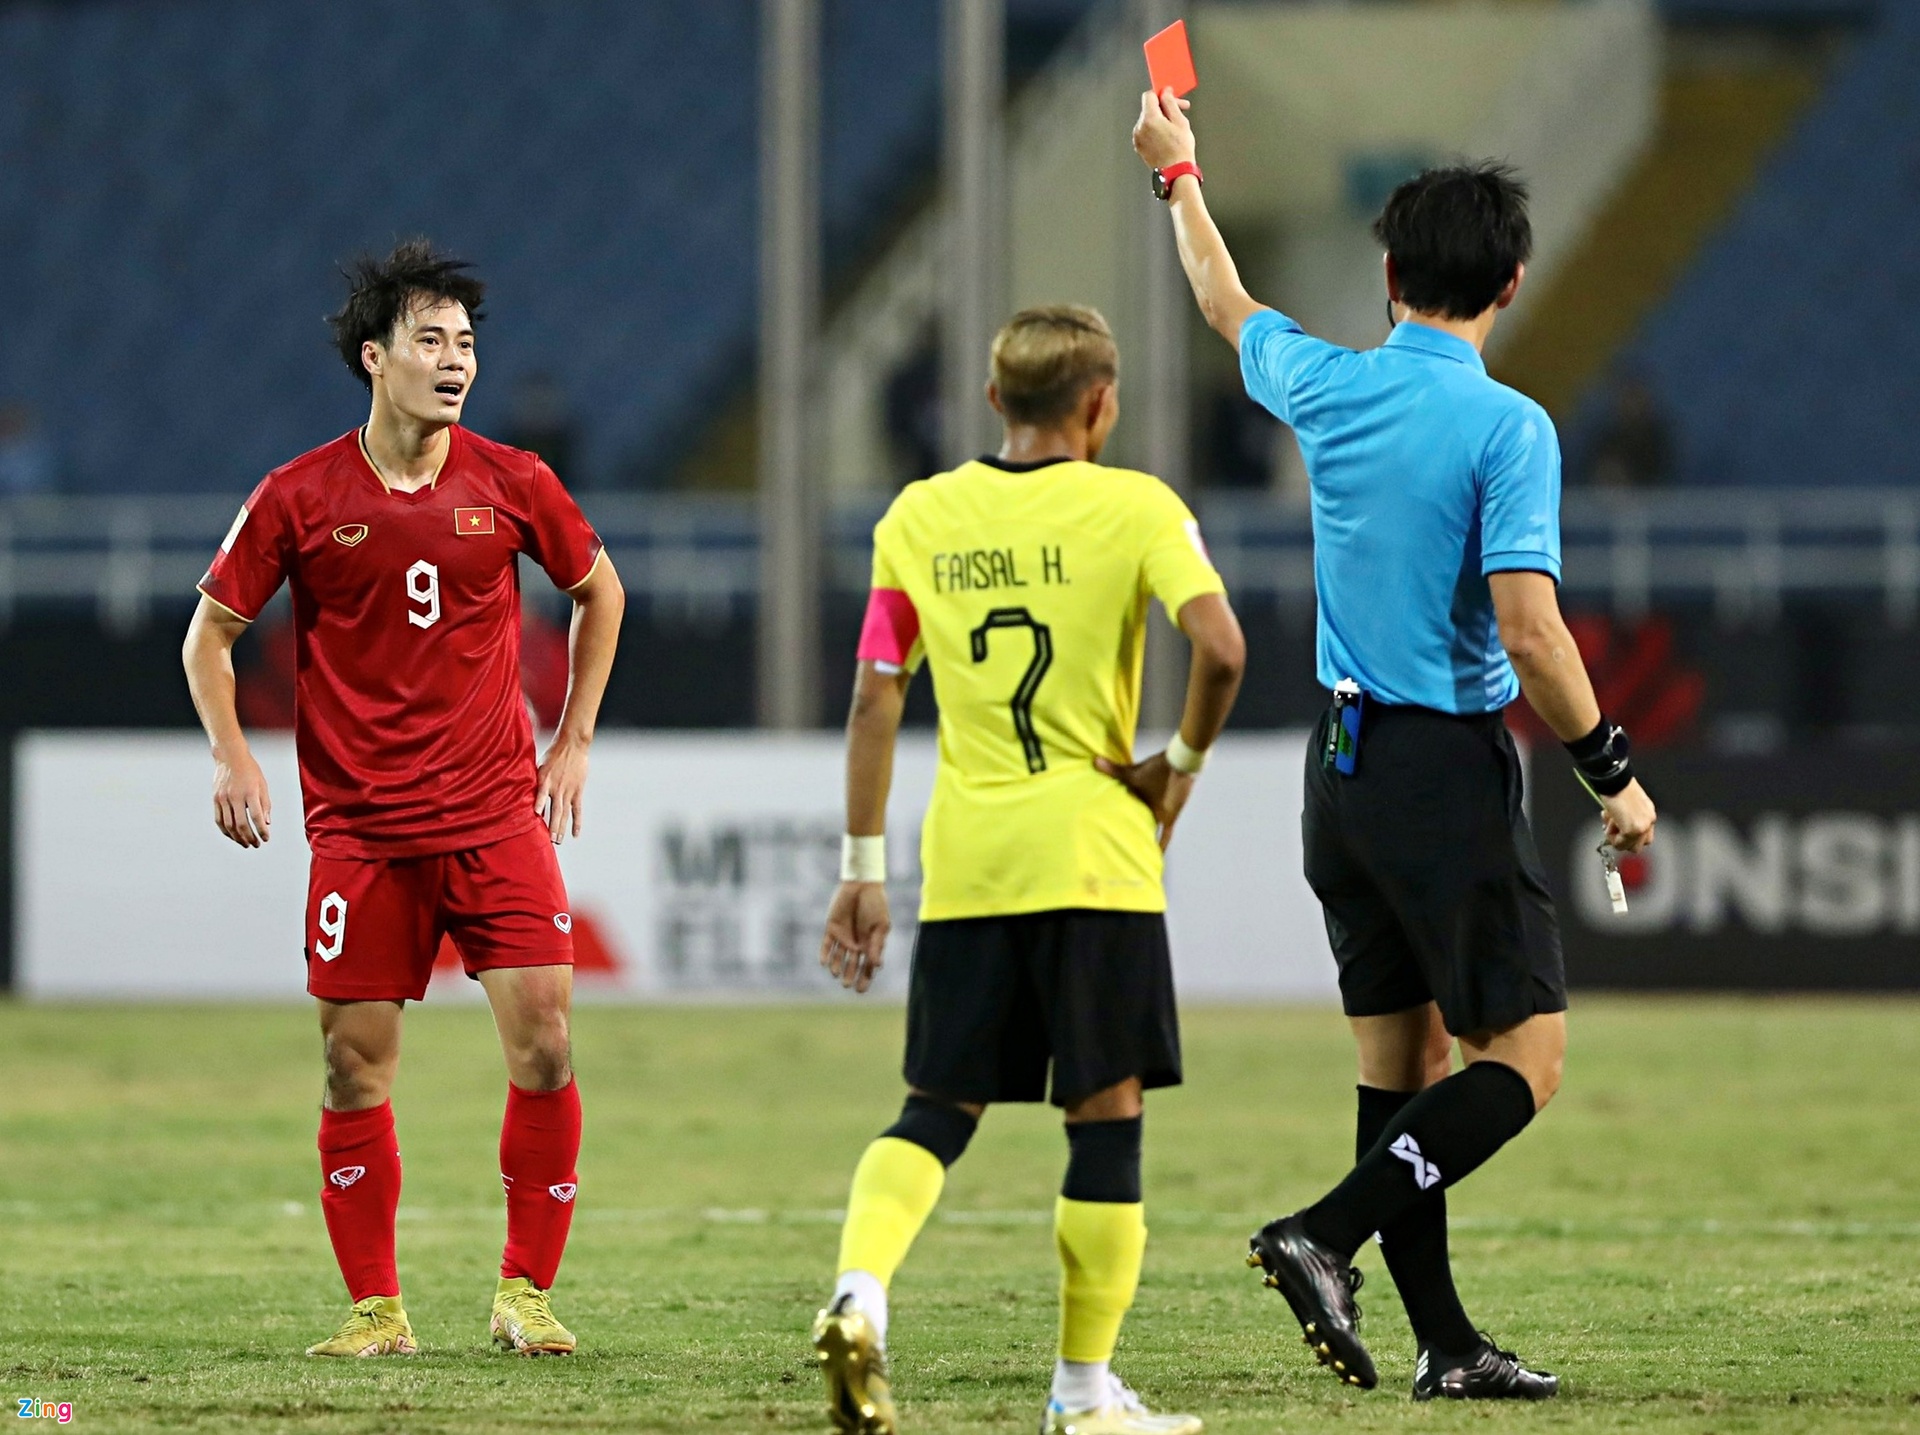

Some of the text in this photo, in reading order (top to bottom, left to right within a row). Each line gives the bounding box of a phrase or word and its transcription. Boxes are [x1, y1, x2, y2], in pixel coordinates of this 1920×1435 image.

[405, 559, 441, 629] 9
[932, 545, 1071, 594] FAISAL H.
[970, 606, 1053, 774] 7
[315, 890, 348, 962] 9
